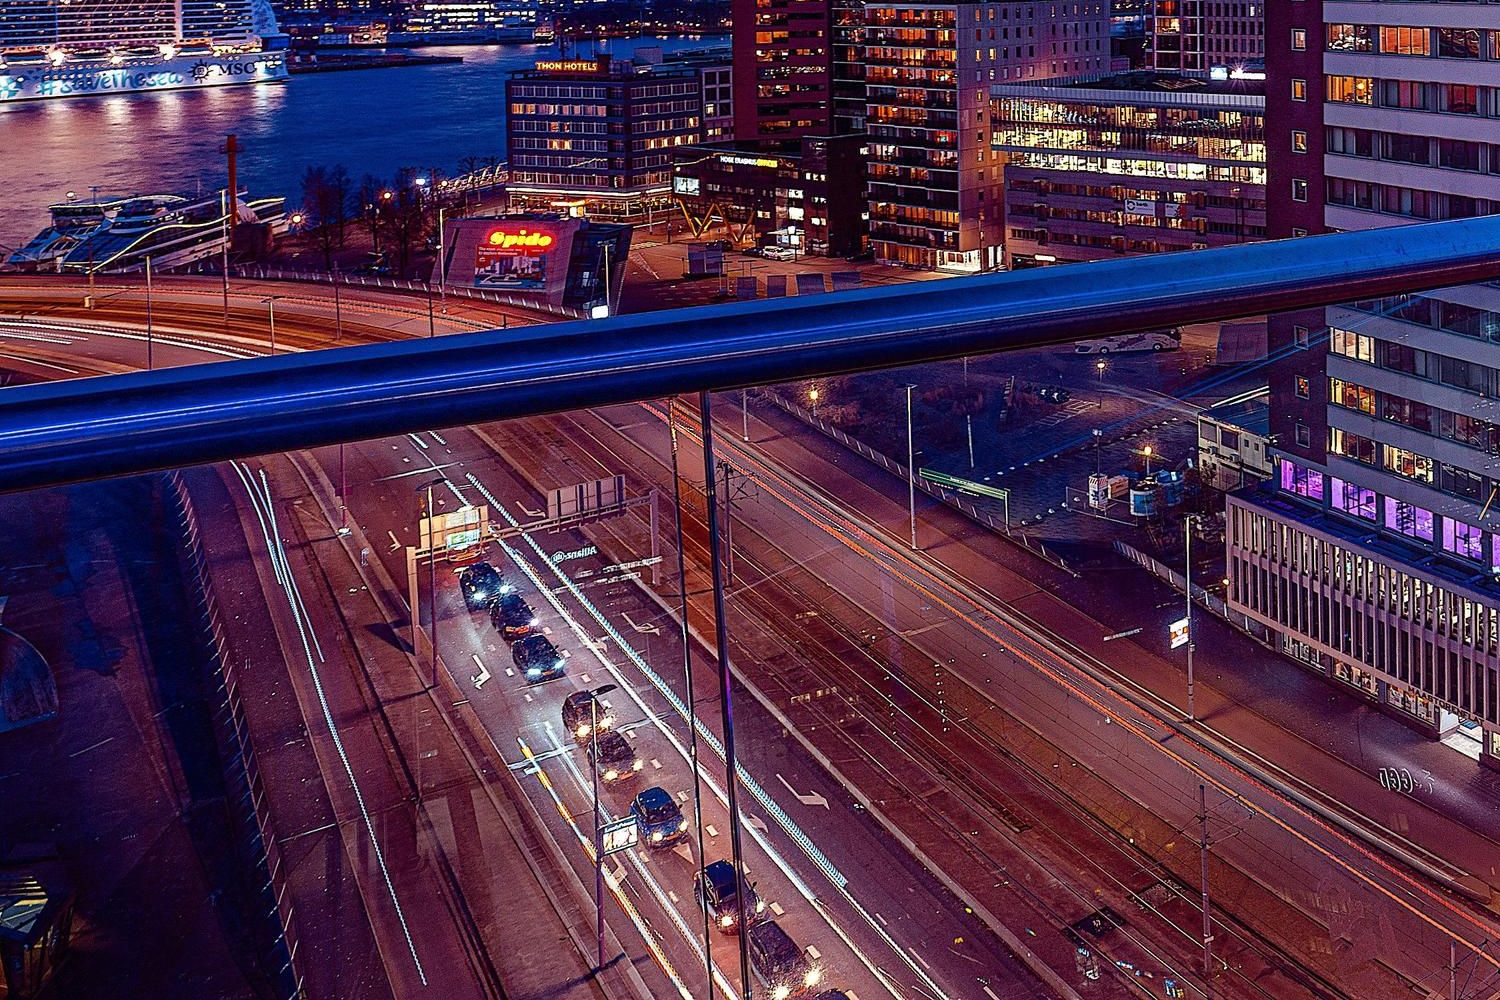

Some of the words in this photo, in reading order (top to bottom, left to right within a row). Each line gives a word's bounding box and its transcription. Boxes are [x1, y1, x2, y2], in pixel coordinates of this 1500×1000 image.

[218, 61, 256, 76] MSC
[536, 62, 562, 71] THON
[564, 62, 597, 71] HOTELS
[489, 229, 552, 248] Spido
